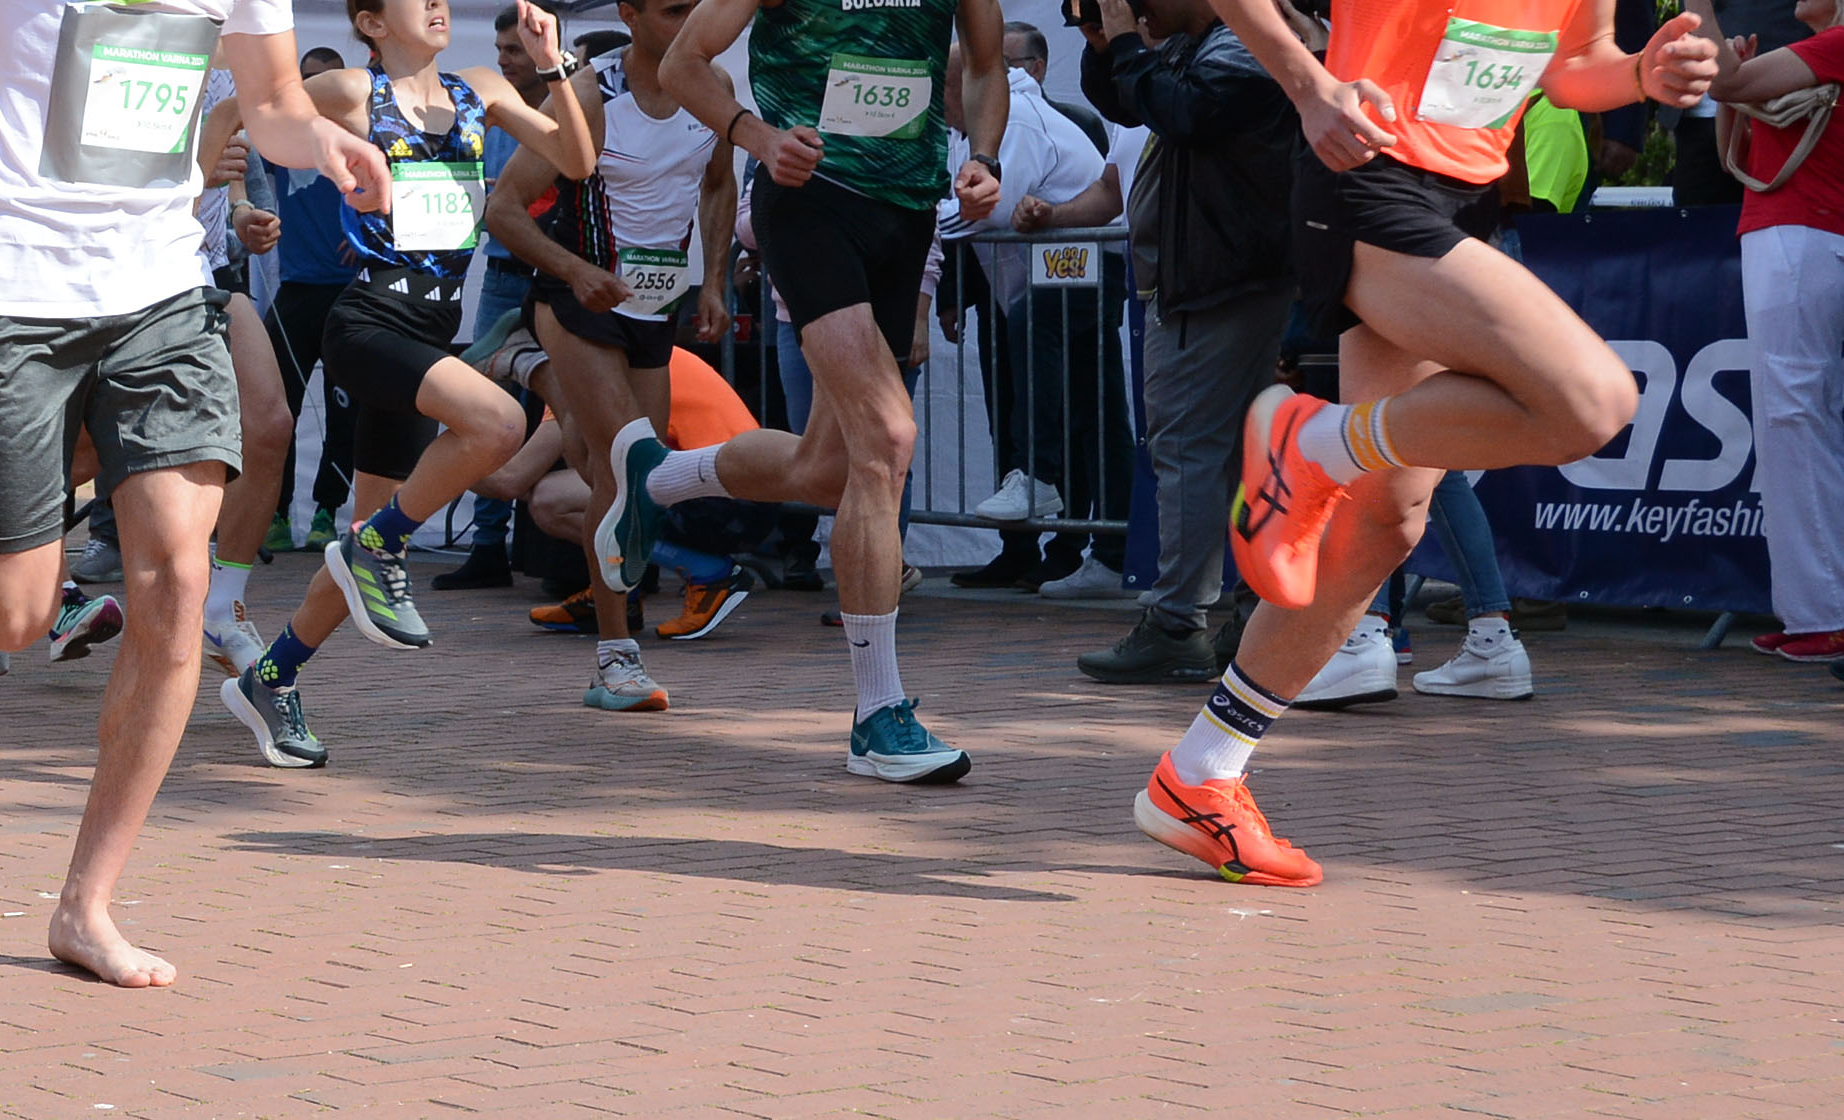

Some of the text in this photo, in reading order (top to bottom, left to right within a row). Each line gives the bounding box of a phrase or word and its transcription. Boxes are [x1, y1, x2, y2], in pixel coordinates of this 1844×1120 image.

[103, 47, 160, 62] MARATHON
[161, 51, 191, 65] VARNA
[843, 61, 887, 73] MARATHON
[887, 65, 912, 75] VARNA
[1464, 60, 1524, 90] 1634
[120, 80, 189, 115] 1795
[853, 84, 911, 108] 1638
[422, 192, 473, 214] 1182
[626, 253, 661, 263] MARATHON
[633, 271, 676, 291] 2556
[1534, 497, 1767, 543] www.keyfashi
